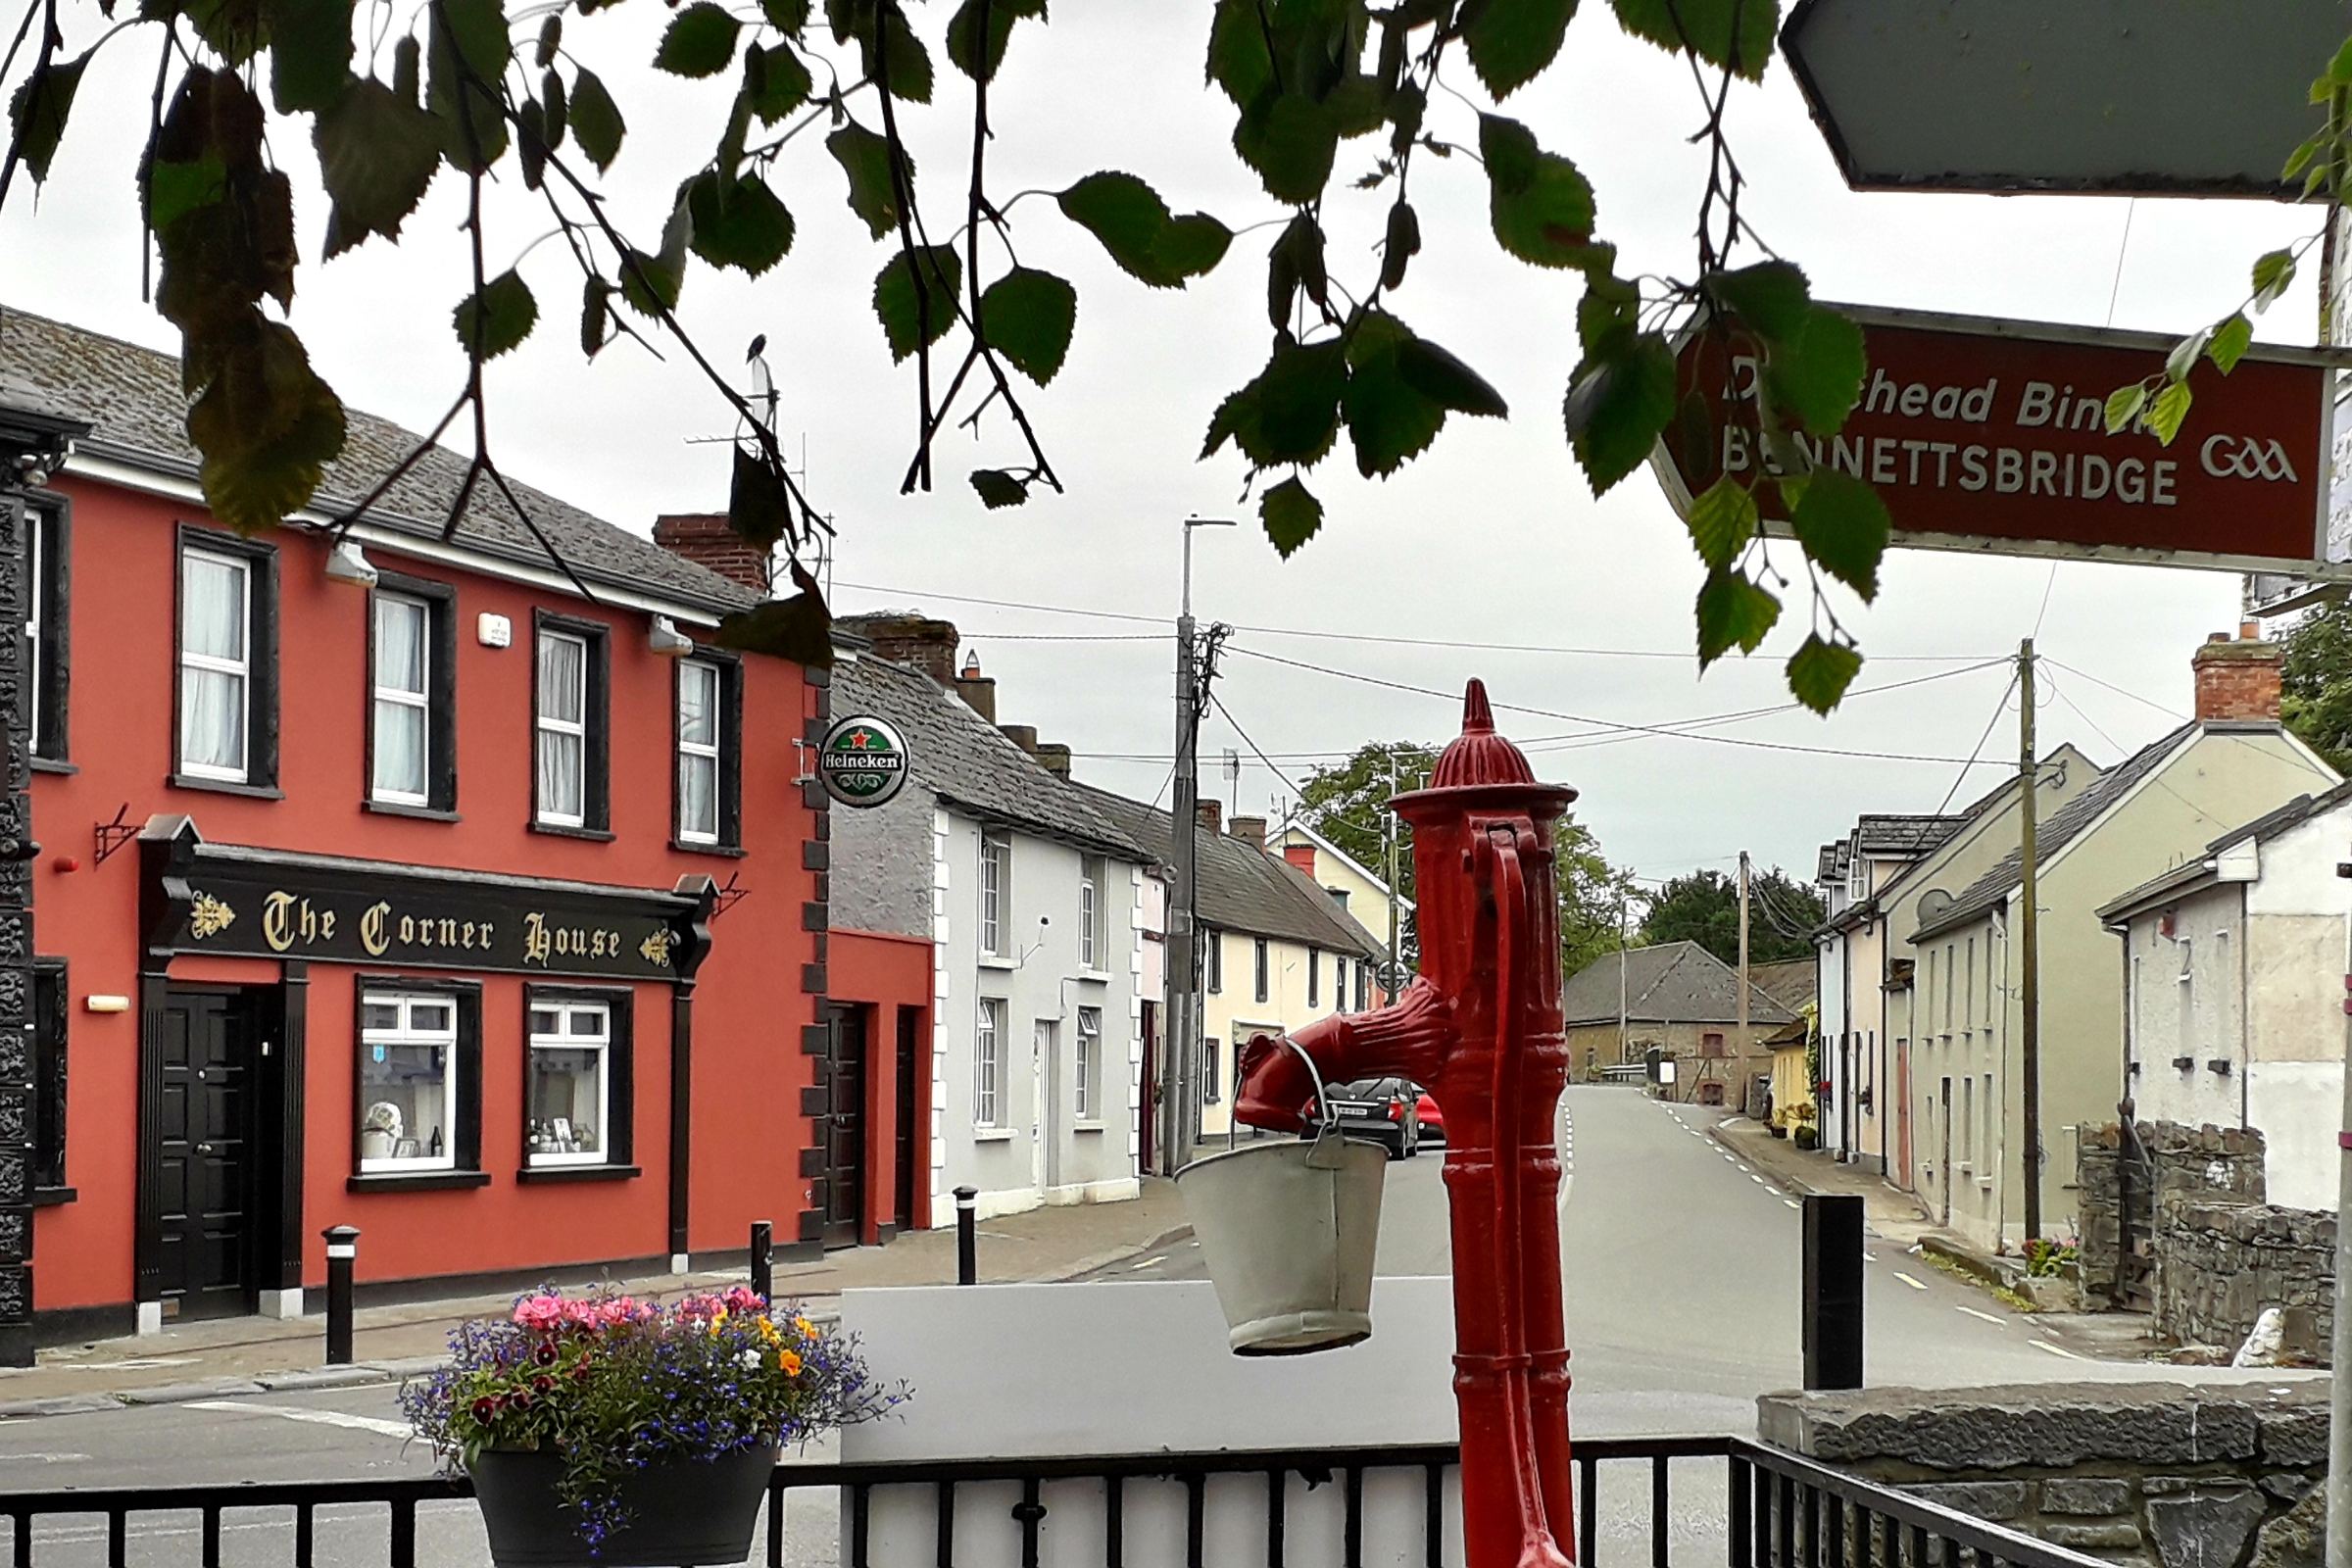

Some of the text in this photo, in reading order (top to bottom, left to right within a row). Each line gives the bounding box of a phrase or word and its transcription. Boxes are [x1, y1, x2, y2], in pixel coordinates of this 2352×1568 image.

[1722, 356, 2180, 438] Dhead Bini
[825, 754, 899, 768] Heineken
[263, 890, 620, 969] The Corner House
